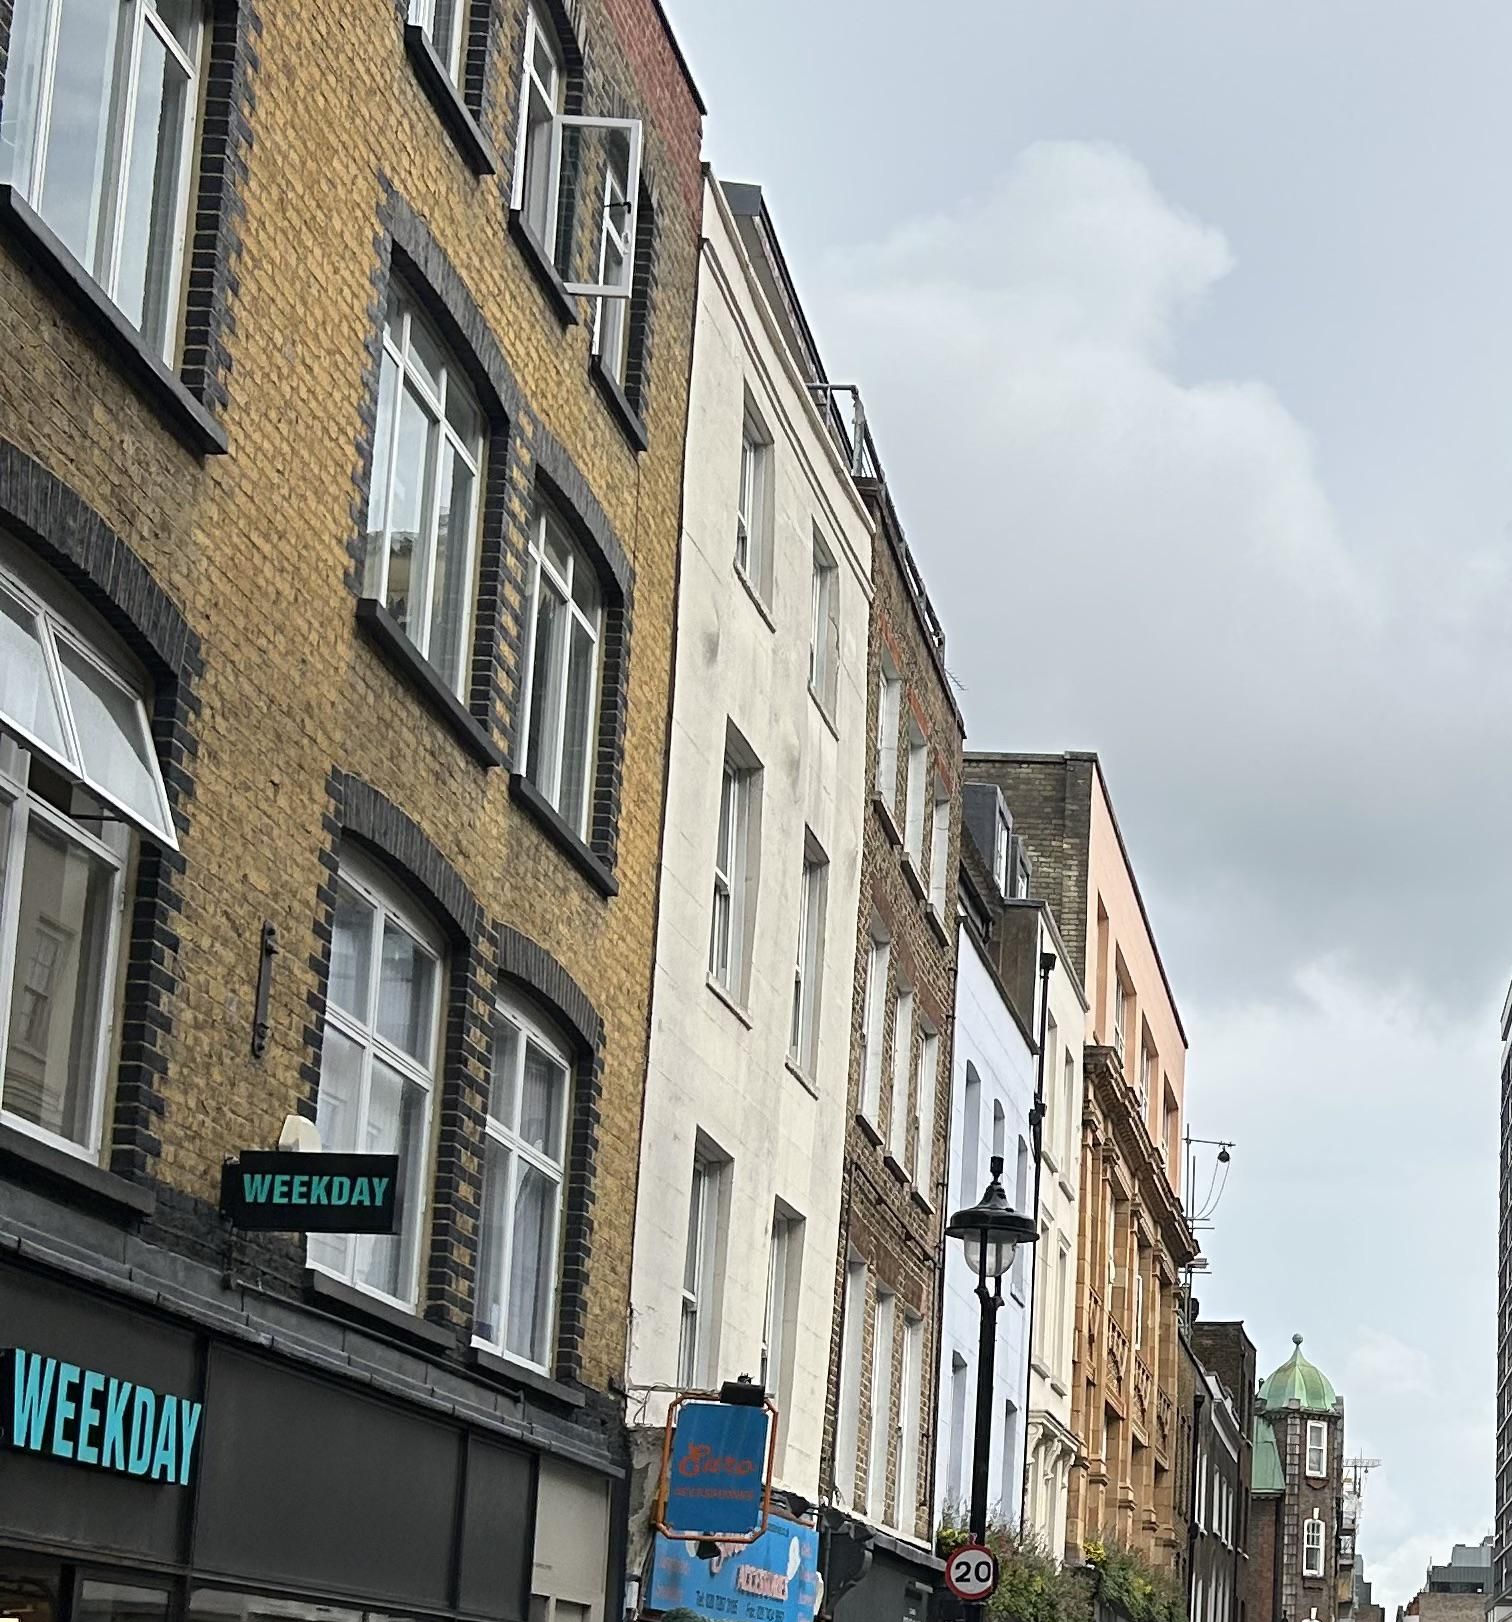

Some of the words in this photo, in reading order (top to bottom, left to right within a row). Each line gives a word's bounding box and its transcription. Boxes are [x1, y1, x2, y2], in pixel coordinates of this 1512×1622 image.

[243, 1172, 389, 1207] WEEKDAY
[13, 1347, 202, 1486] WEEKDAY
[954, 1561, 992, 1583] 20
